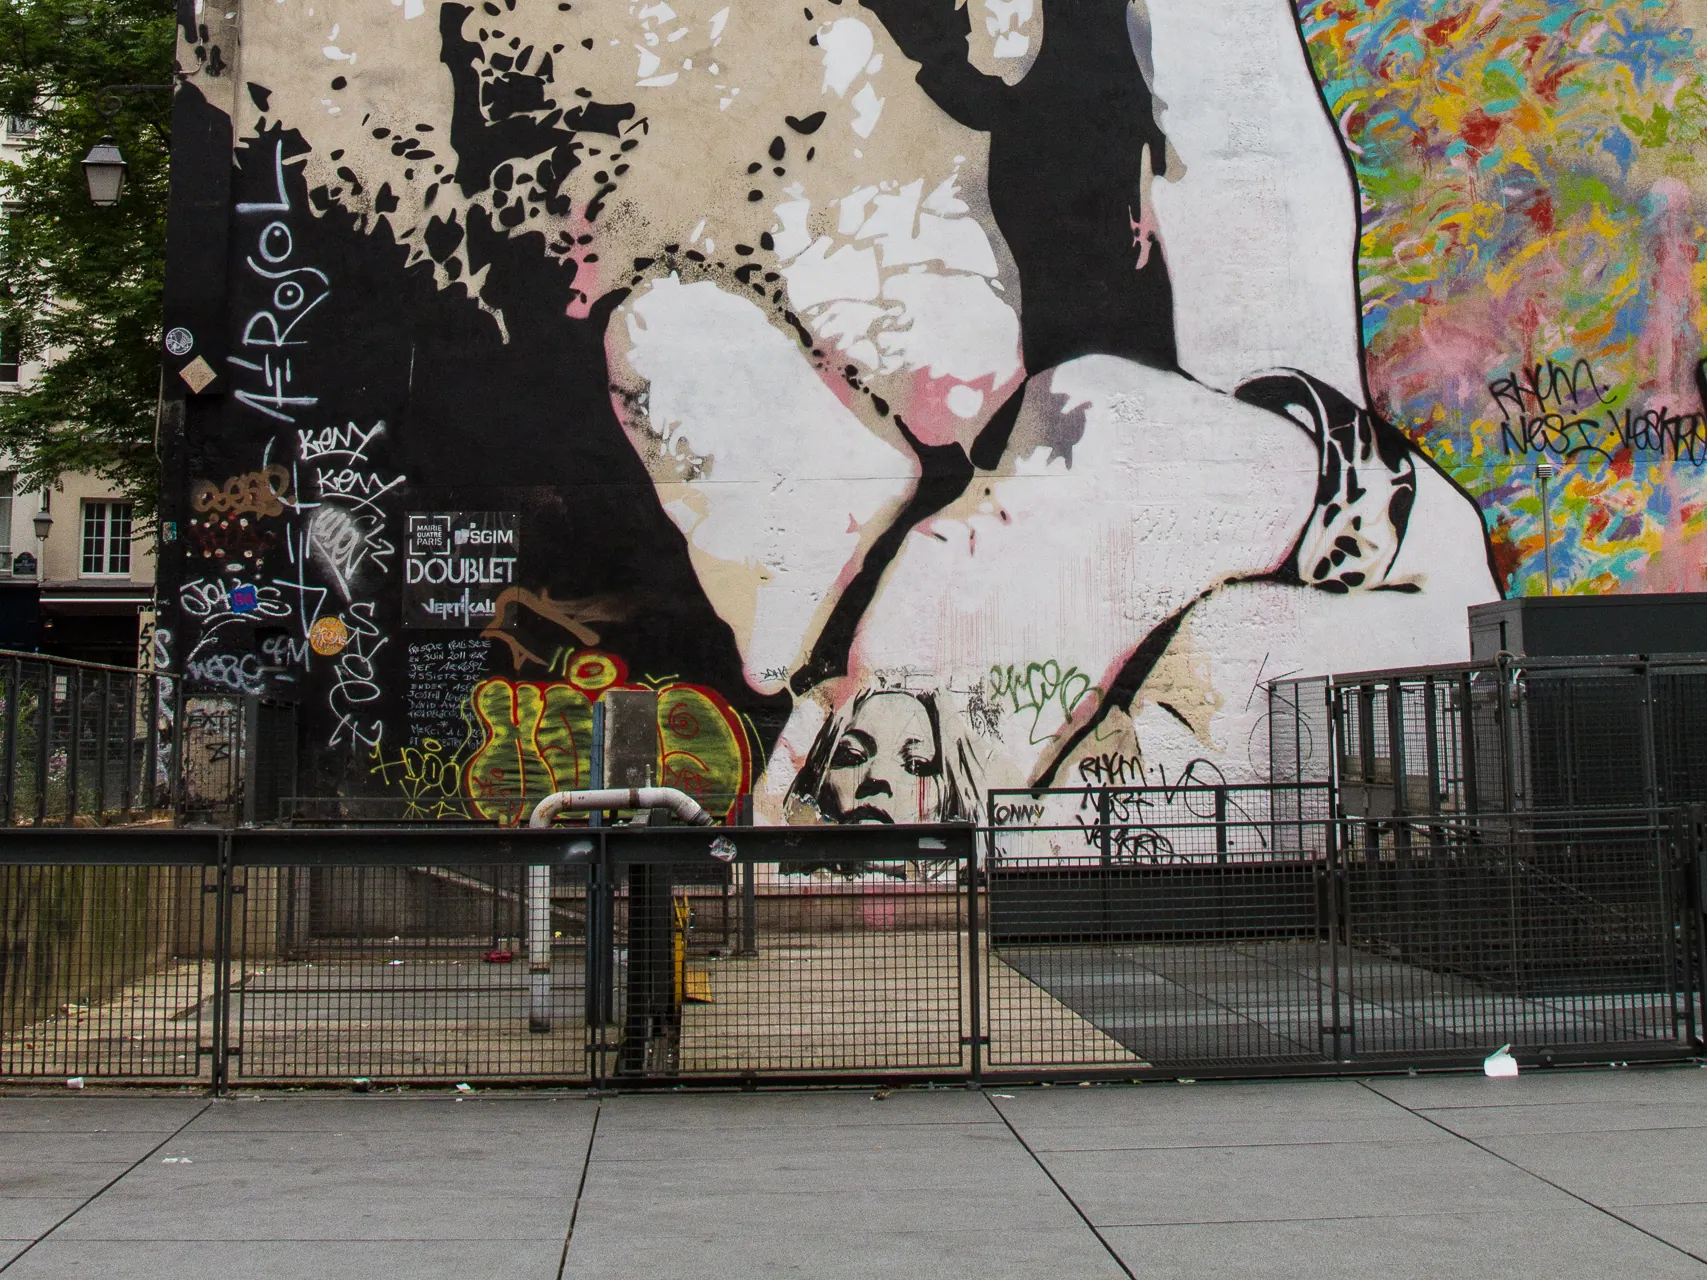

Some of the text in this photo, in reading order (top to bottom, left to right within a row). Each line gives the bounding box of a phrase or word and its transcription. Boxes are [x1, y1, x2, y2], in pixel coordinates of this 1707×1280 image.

[416, 538, 443, 546] PARIS
[470, 529, 513, 544] SGIM
[406, 557, 517, 584] DOUBLET
[447, 650, 466, 661] 2011
[409, 662, 437, 672] JEF
